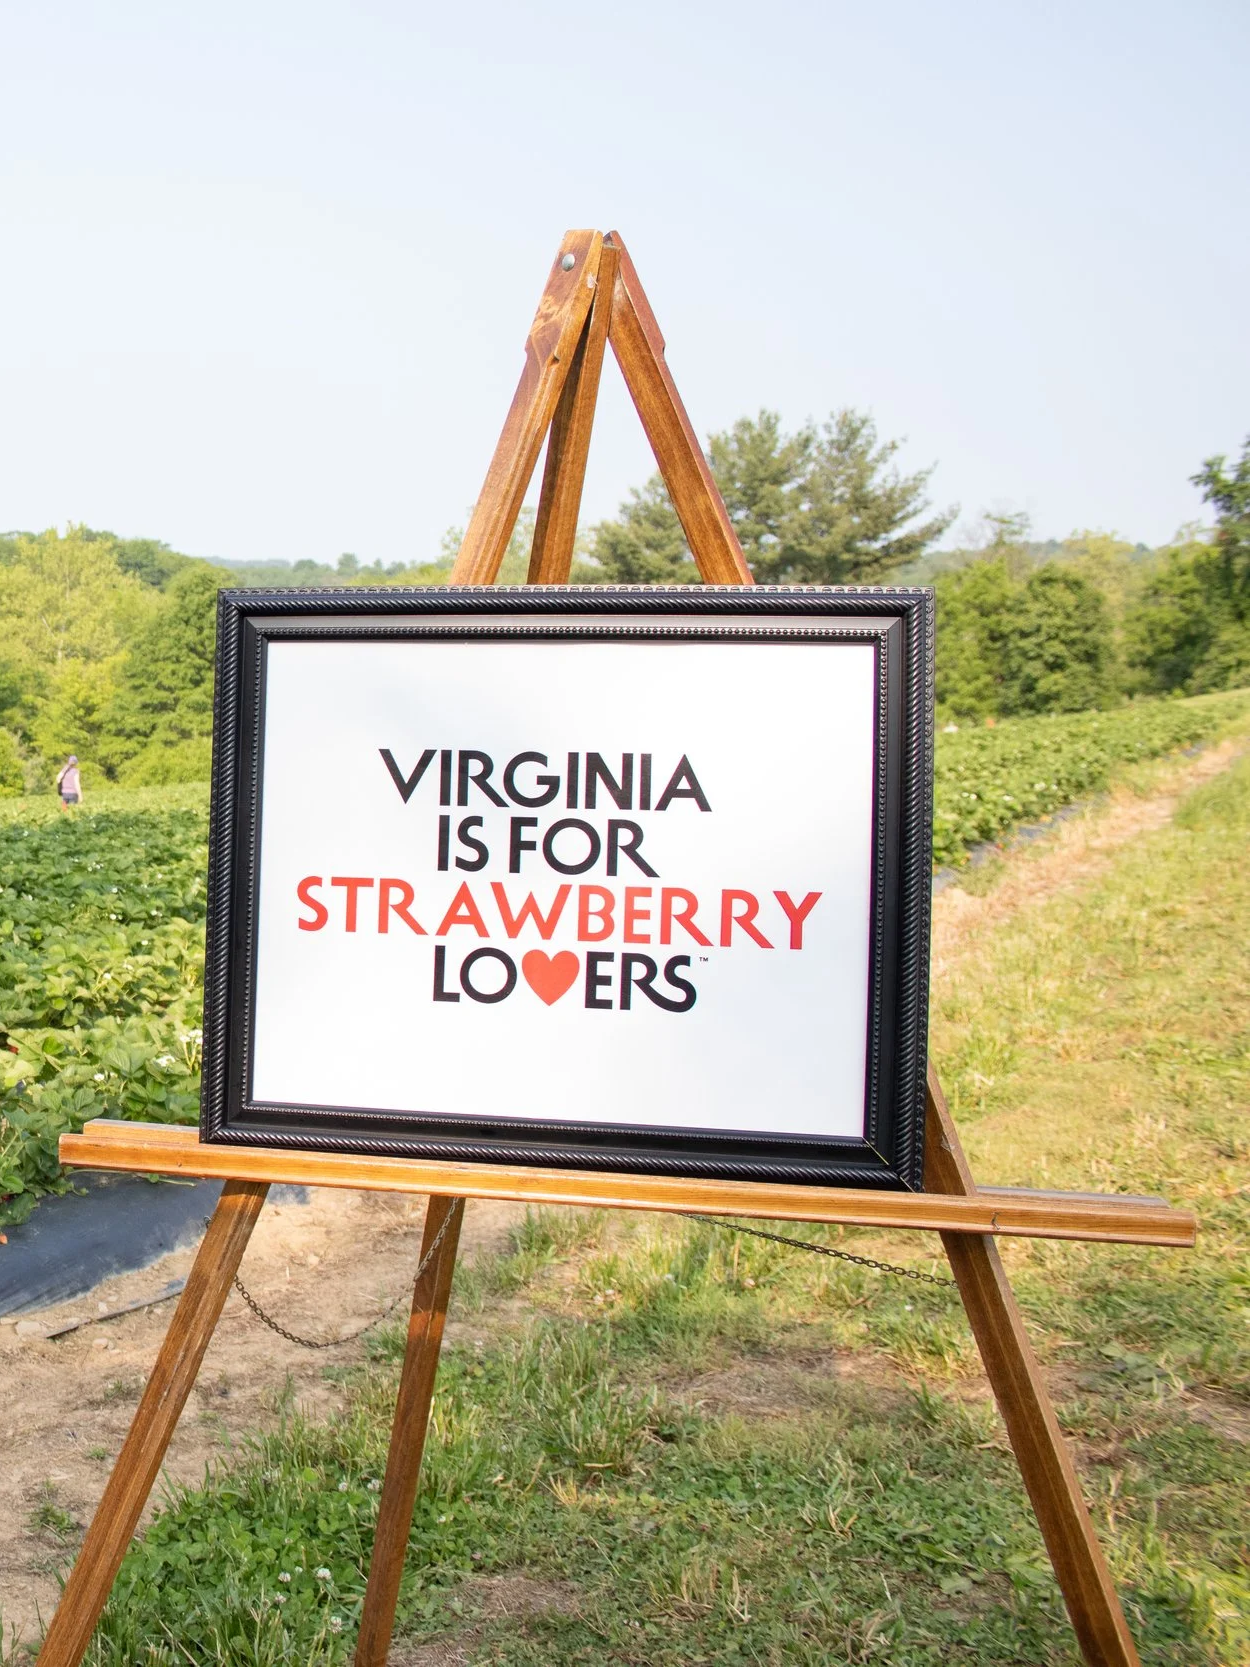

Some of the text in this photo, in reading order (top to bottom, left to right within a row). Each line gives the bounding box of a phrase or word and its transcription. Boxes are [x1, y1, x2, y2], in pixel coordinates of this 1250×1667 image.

[378, 748, 712, 812] VIRGINIA
[437, 814, 660, 878] IS FOR
[296, 875, 823, 951] STRAWBERRY
